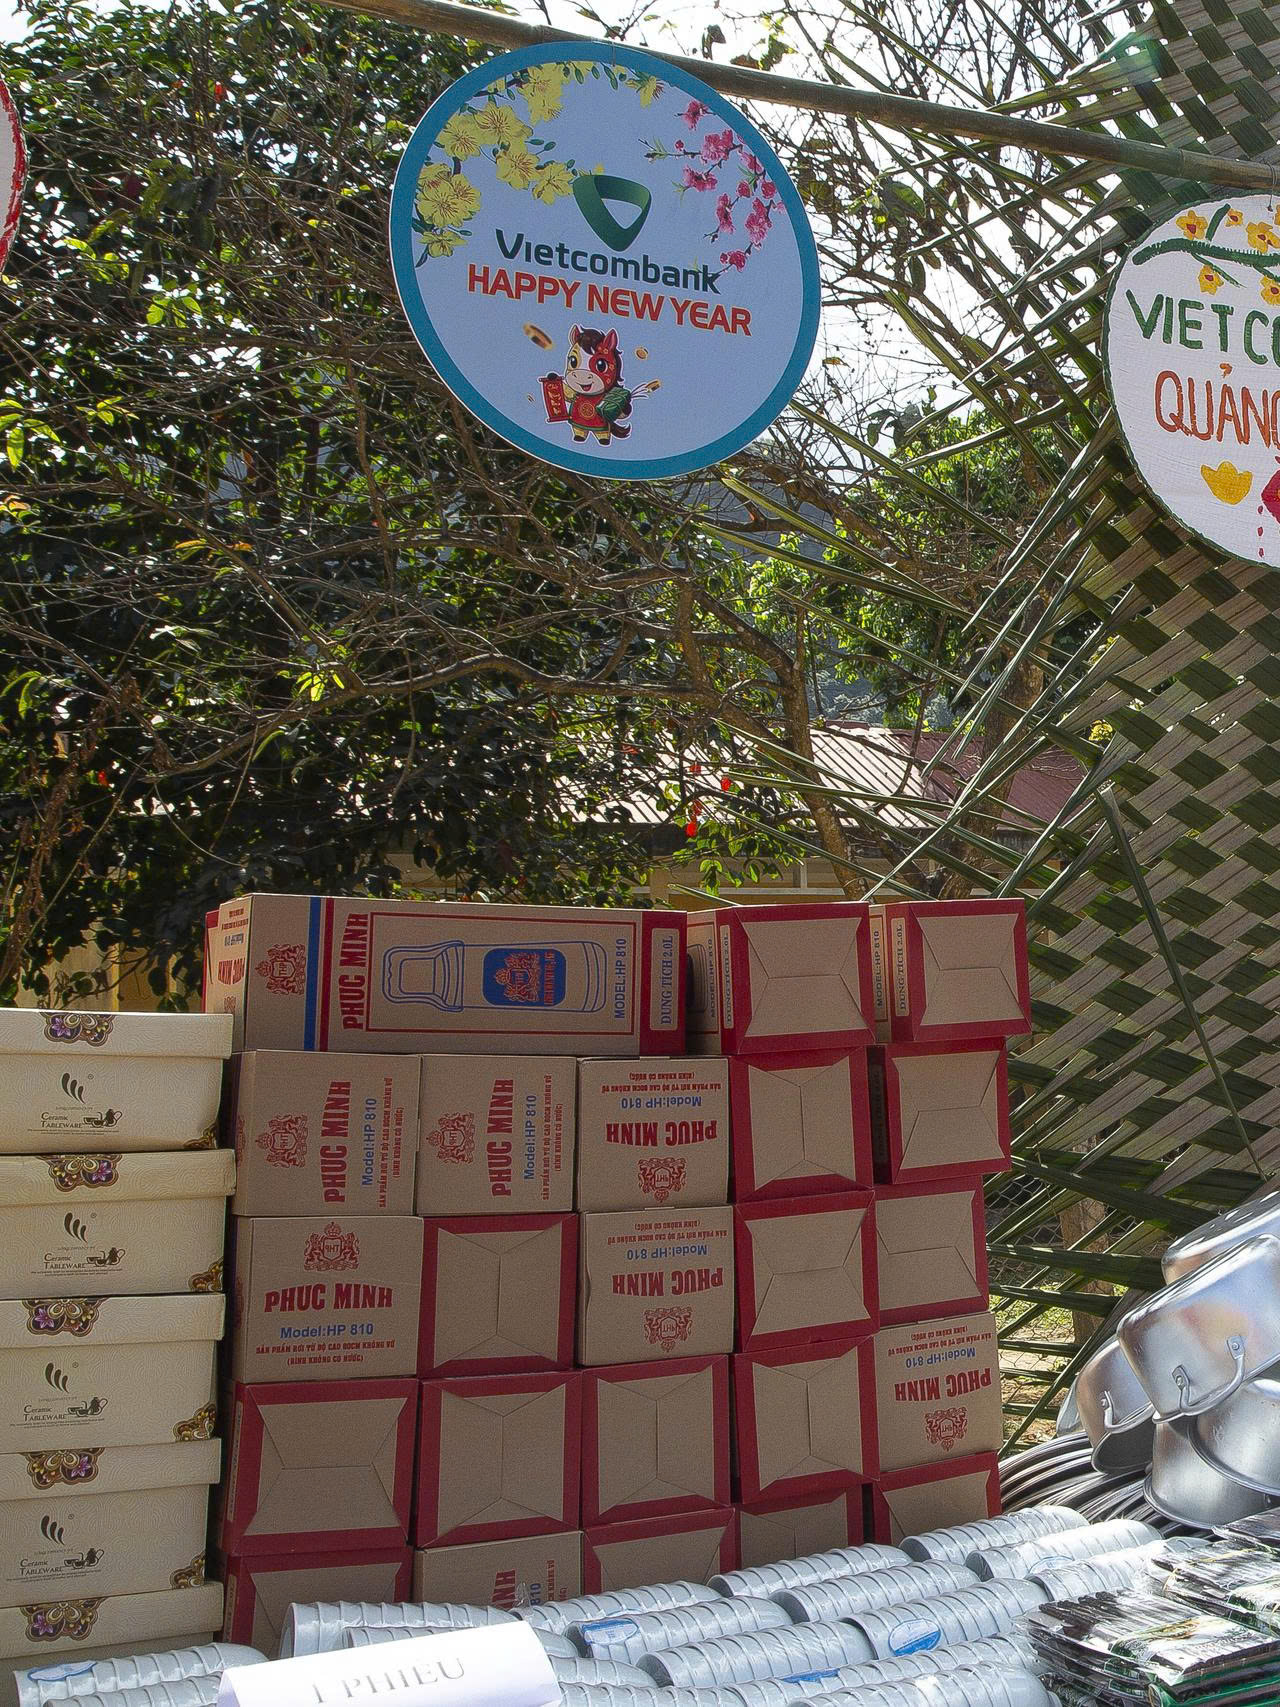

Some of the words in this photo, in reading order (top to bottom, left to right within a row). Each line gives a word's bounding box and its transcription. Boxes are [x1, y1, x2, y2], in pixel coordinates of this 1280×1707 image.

[496, 228, 721, 295] Vietcombank
[468, 263, 580, 312] HAPPY
[587, 282, 664, 322] NEW
[670, 298, 752, 337] YEAR
[340, 913, 369, 971] MINH
[615, 938, 627, 957] 810
[662, 935, 673, 957] 2.0L
[341, 973, 368, 1031] PHUC
[660, 990, 672, 1024] DUNG
[321, 1081, 350, 1137] MINH
[364, 1097, 376, 1120] 810
[487, 1079, 512, 1133] MINH
[526, 1095, 537, 1116] 810
[621, 1098, 642, 1109] 810
[40, 1120, 83, 1129] TABLEWARE
[606, 1122, 658, 1146] MINH
[666, 1121, 717, 1146] PHUC
[319, 1145, 347, 1202] PHUC
[486, 1141, 511, 1195] PHUC
[43, 1261, 86, 1269] TABLEWARE
[627, 1248, 647, 1260] 810
[612, 1272, 664, 1296] MINH
[672, 1268, 723, 1295] PHUC
[264, 1283, 325, 1312] PHUC
[333, 1283, 392, 1309] MINH
[350, 1323, 374, 1335] 810
[906, 1356, 924, 1368] 810
[894, 1377, 940, 1401] MINH
[946, 1368, 991, 1397] PHUC
[23, 1413, 66, 1421] TABLEWARE
[19, 1567, 62, 1576] TABLEWARE
[491, 1569, 516, 1610] INH
